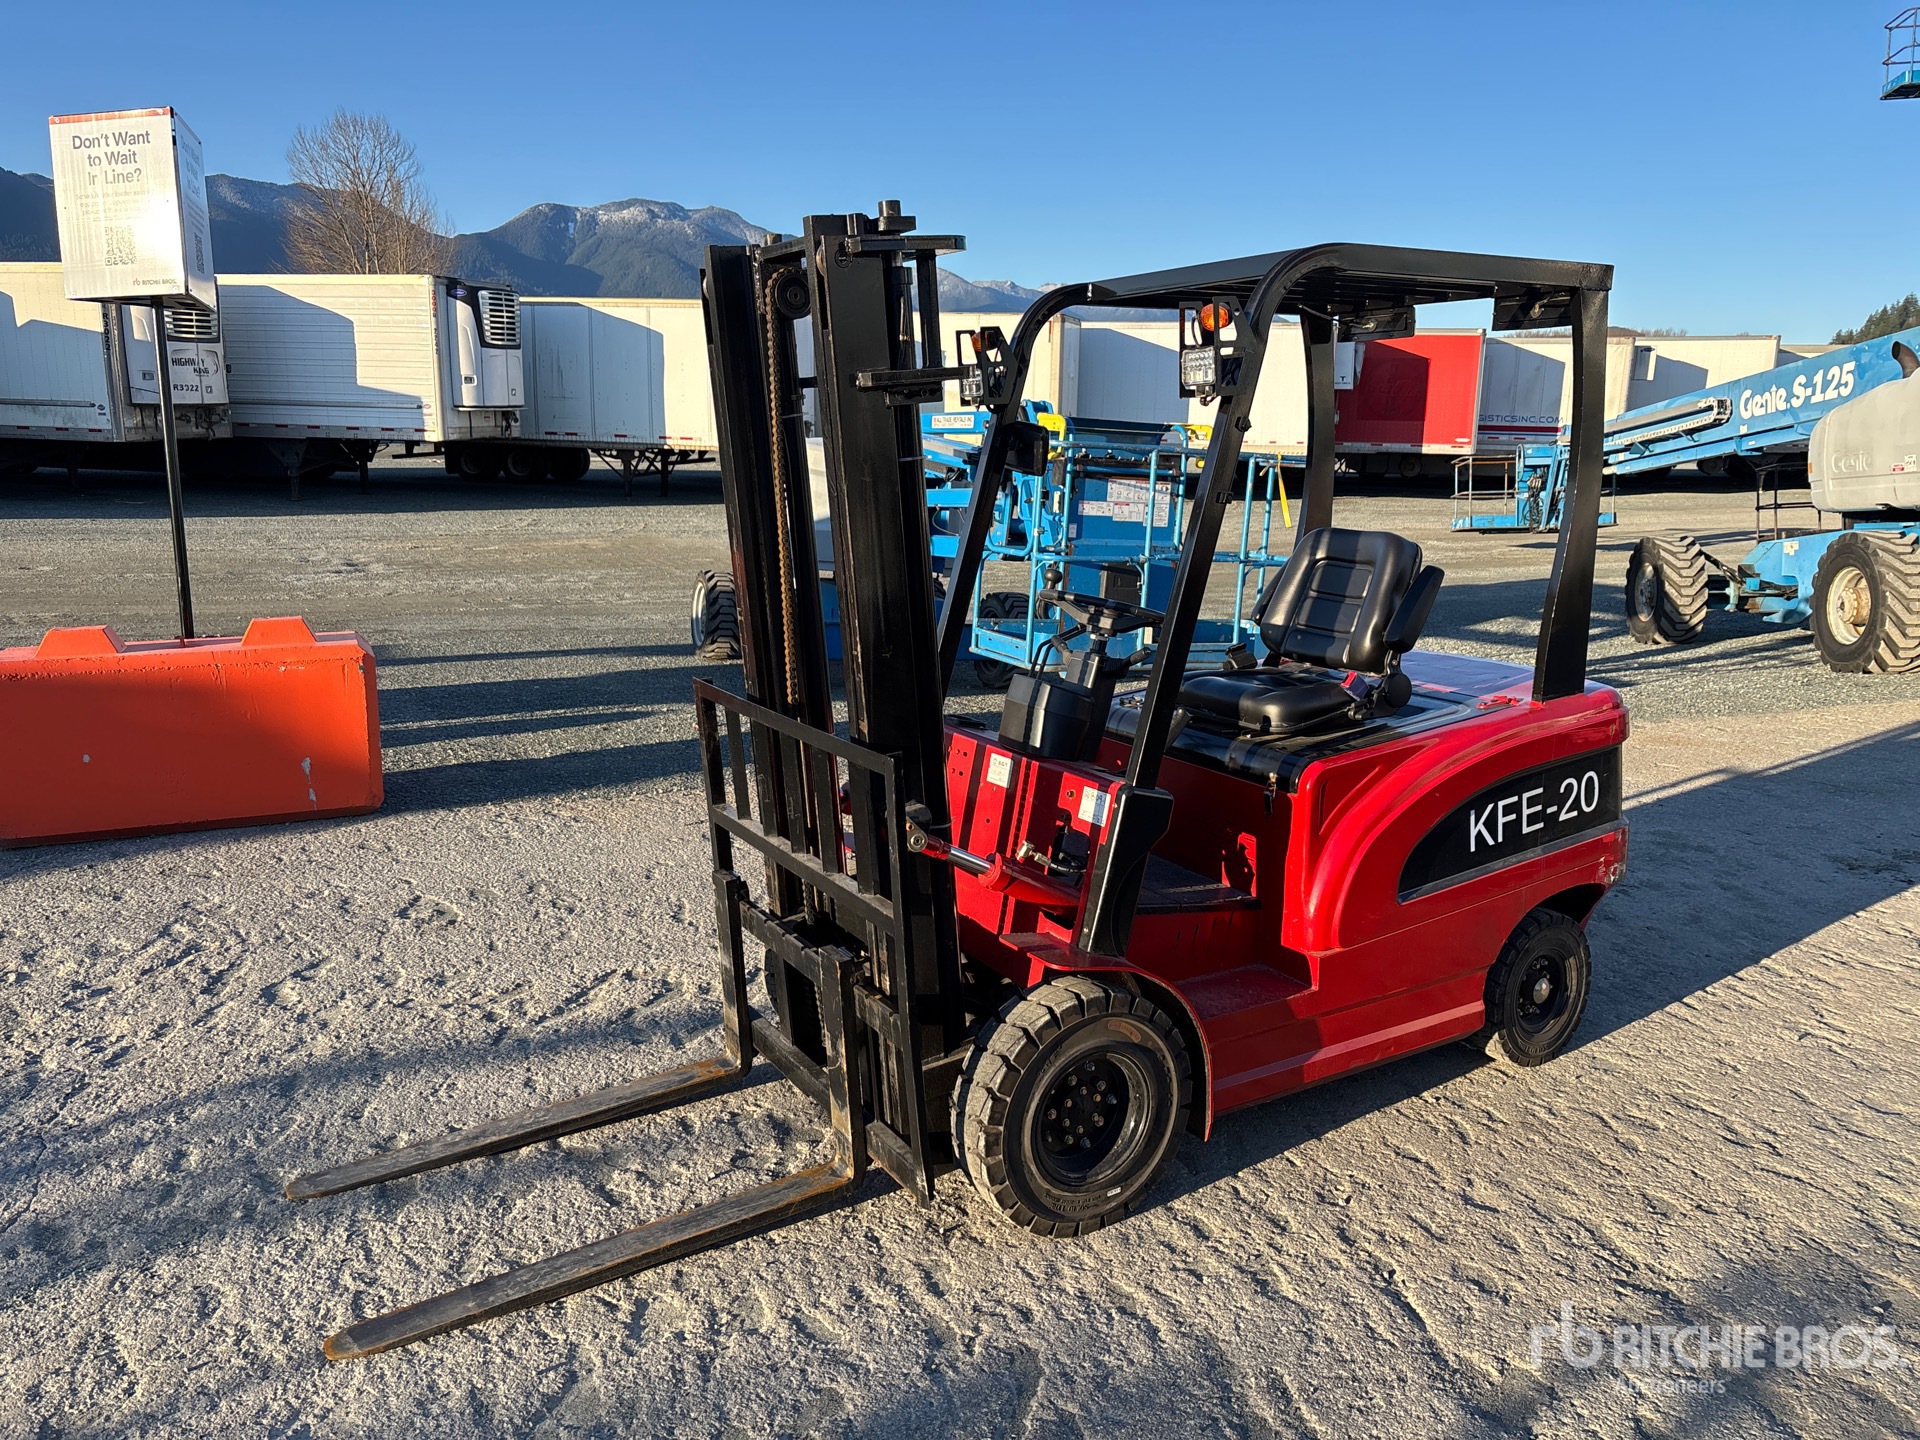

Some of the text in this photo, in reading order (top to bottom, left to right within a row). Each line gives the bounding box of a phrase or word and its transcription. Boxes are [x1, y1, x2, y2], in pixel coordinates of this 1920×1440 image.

[72, 130, 151, 150] Don't Want
[87, 148, 138, 167] to Wait
[104, 167, 142, 185] Line?
[102, 312, 111, 351] R3022
[1790, 361, 1857, 409] S-125
[1469, 770, 1600, 853] KFE-20
